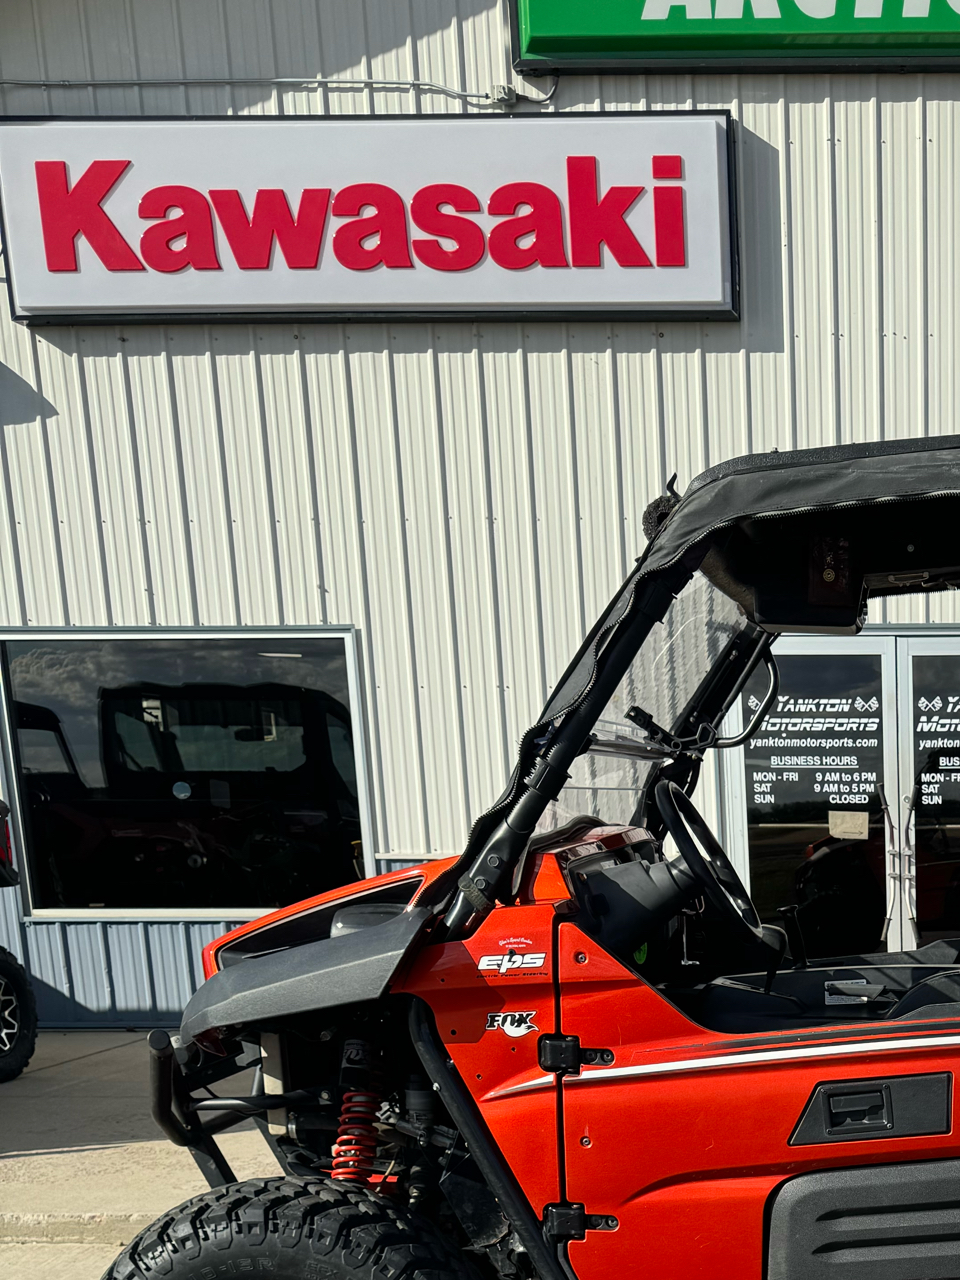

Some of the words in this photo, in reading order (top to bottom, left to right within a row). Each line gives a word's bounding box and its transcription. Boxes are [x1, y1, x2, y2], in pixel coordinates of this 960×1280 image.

[34, 154, 687, 273] Kawasaki
[777, 695, 852, 712] YANKTON
[750, 736, 878, 749] yanktonmotorsports.com
[771, 756, 820, 766] BUSINESS
[823, 756, 858, 766] HOURS
[753, 772, 776, 781] MON
[783, 772, 799, 781] FRI
[815, 772, 822, 781] 9
[824, 772, 840, 781] AM
[841, 772, 851, 781] to
[853, 772, 860, 781] 6
[861, 772, 877, 781] PM
[921, 773, 944, 782] MON
[754, 784, 772, 792] SAT
[814, 784, 821, 792] 9
[823, 784, 839, 792] AM
[840, 784, 850, 792] to
[852, 784, 858, 792] 5
[860, 784, 875, 792] PM
[922, 784, 940, 793] SAT
[754, 795, 775, 803] SUN
[829, 794, 869, 803] CLOSED
[922, 795, 942, 804] SUN
[486, 1011, 537, 1030] FOX
